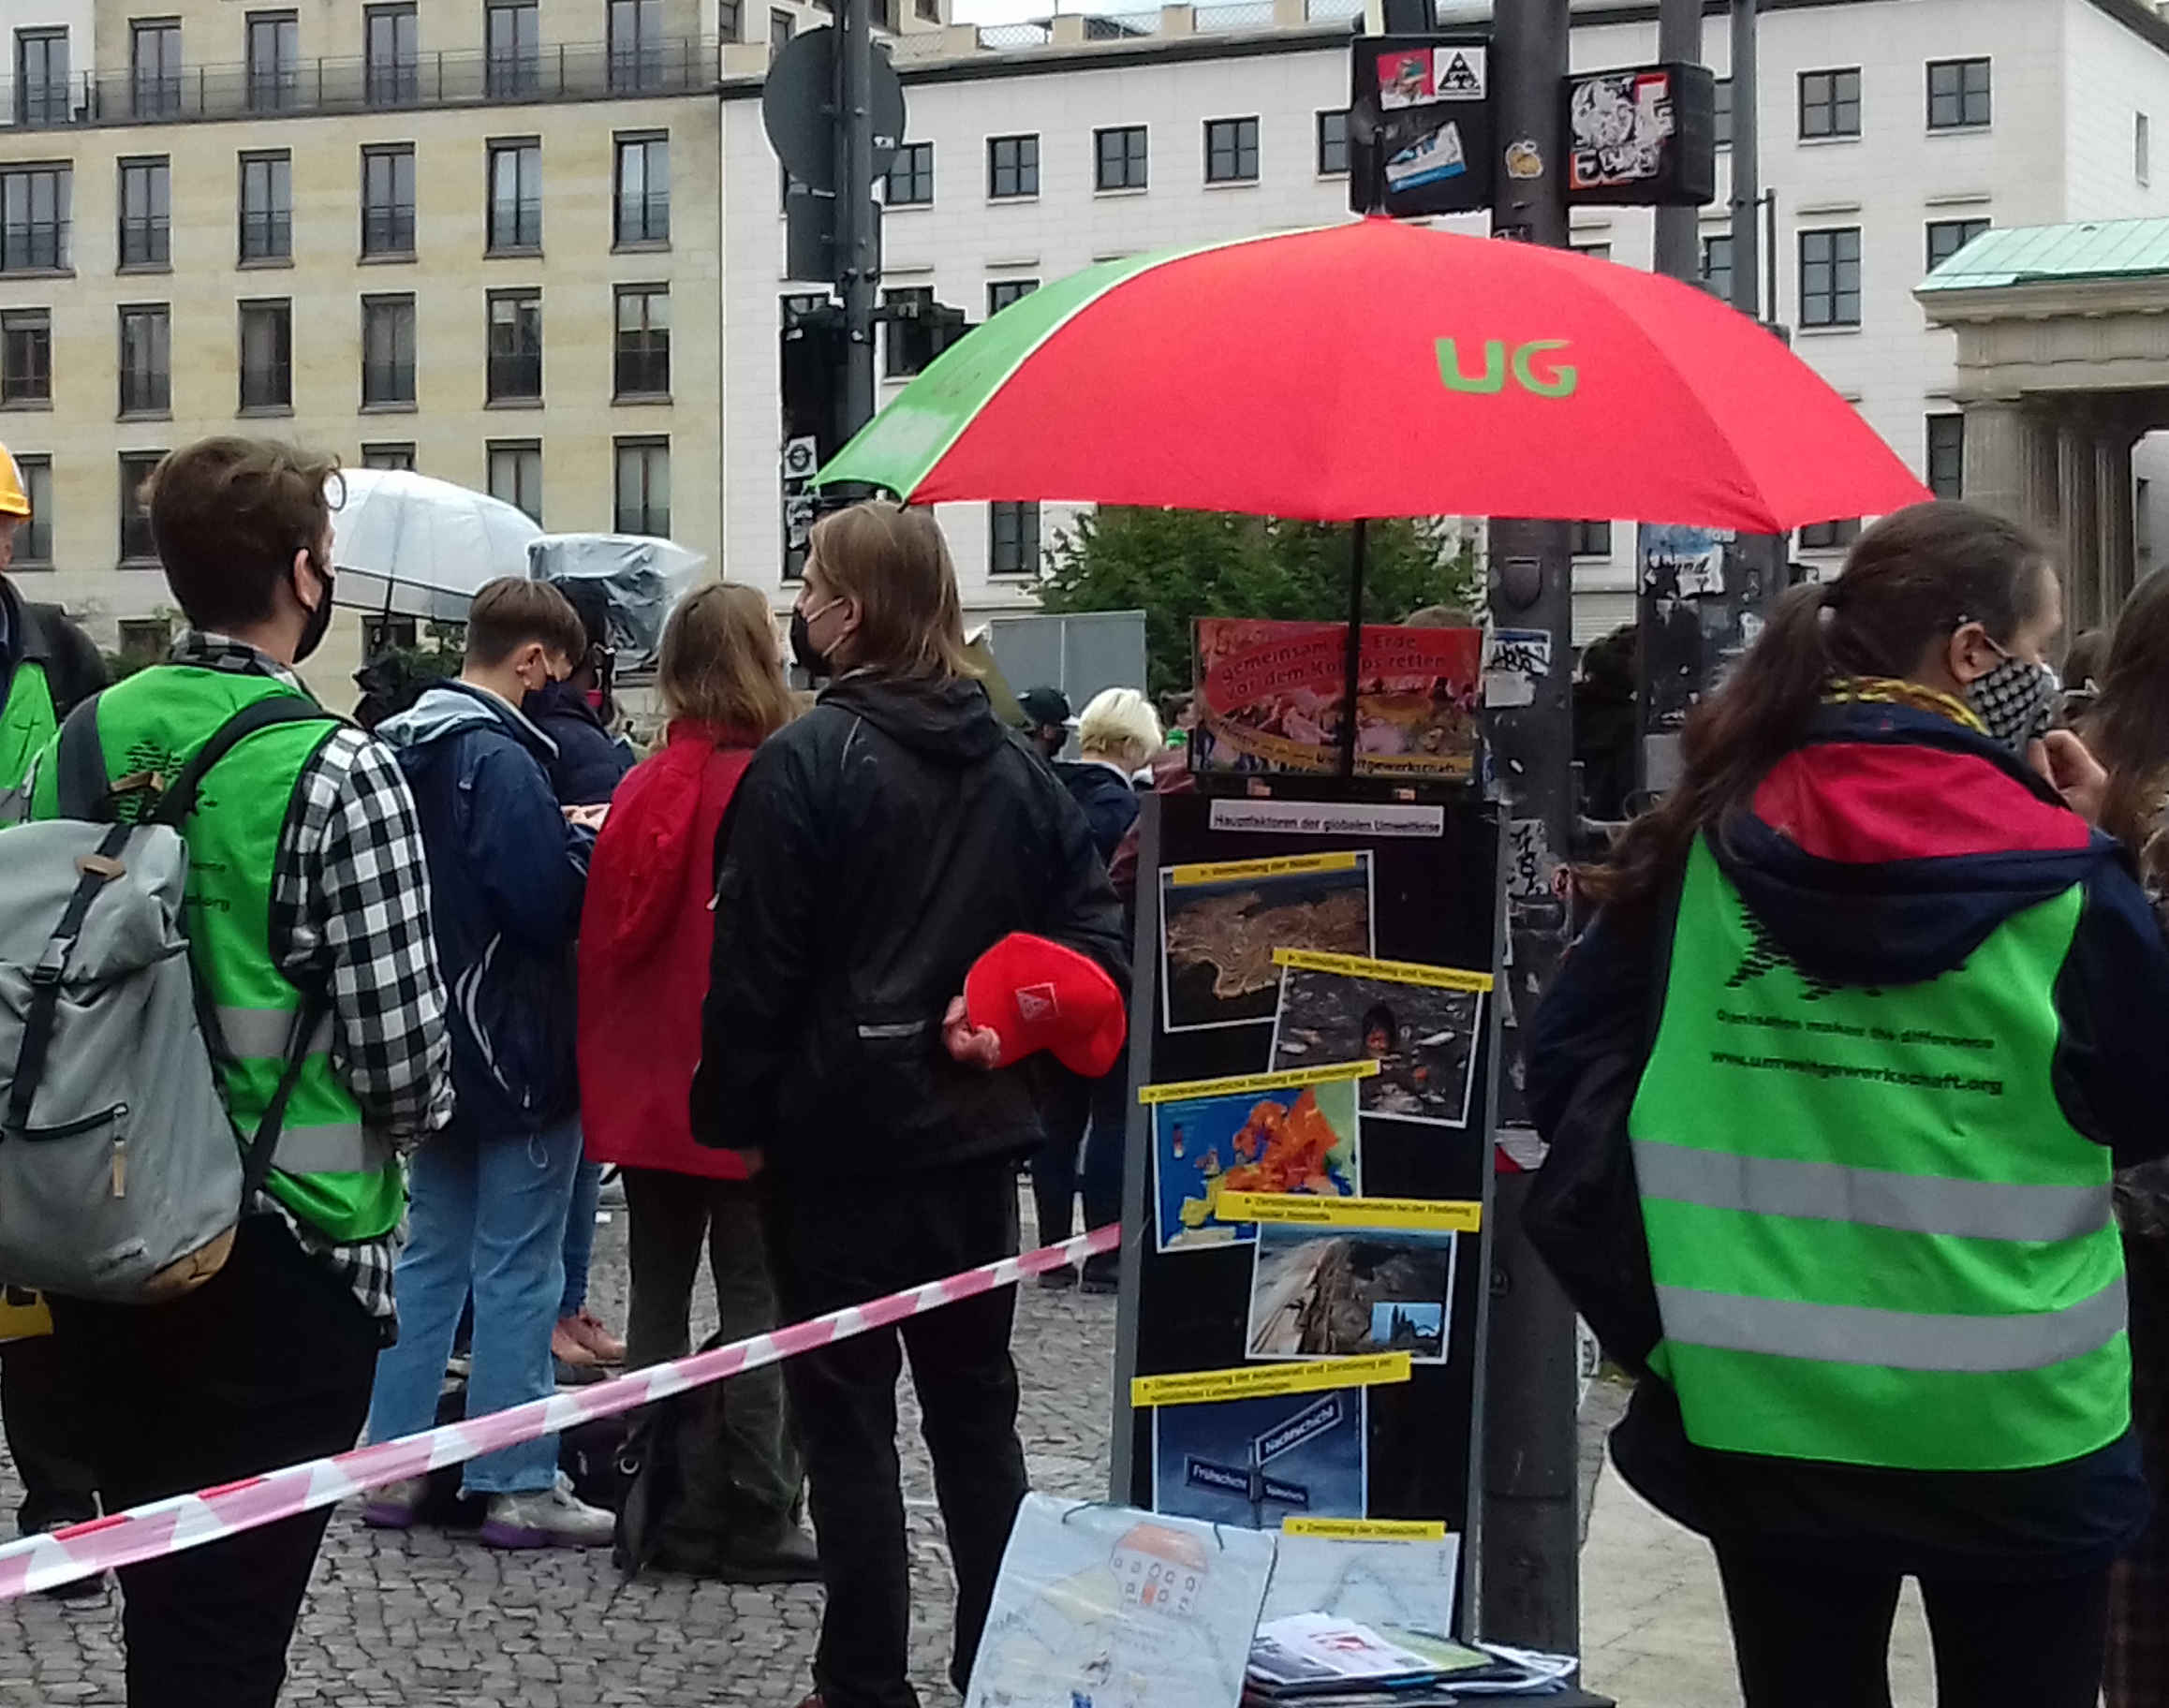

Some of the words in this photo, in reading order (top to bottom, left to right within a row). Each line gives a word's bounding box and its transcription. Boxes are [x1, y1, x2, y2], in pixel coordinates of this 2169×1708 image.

[1435, 336, 1577, 399] UG
[1372, 635, 1416, 650] Erde
[1265, 668, 1304, 685] dem
[1389, 653, 1446, 669] retten
[1214, 816, 1297, 829] Hauptfaktoren
[1300, 817, 1320, 830] der
[1323, 818, 1370, 832] globalen
[1711, 1052, 2002, 1097] www.umweltgewerkschaft.org
